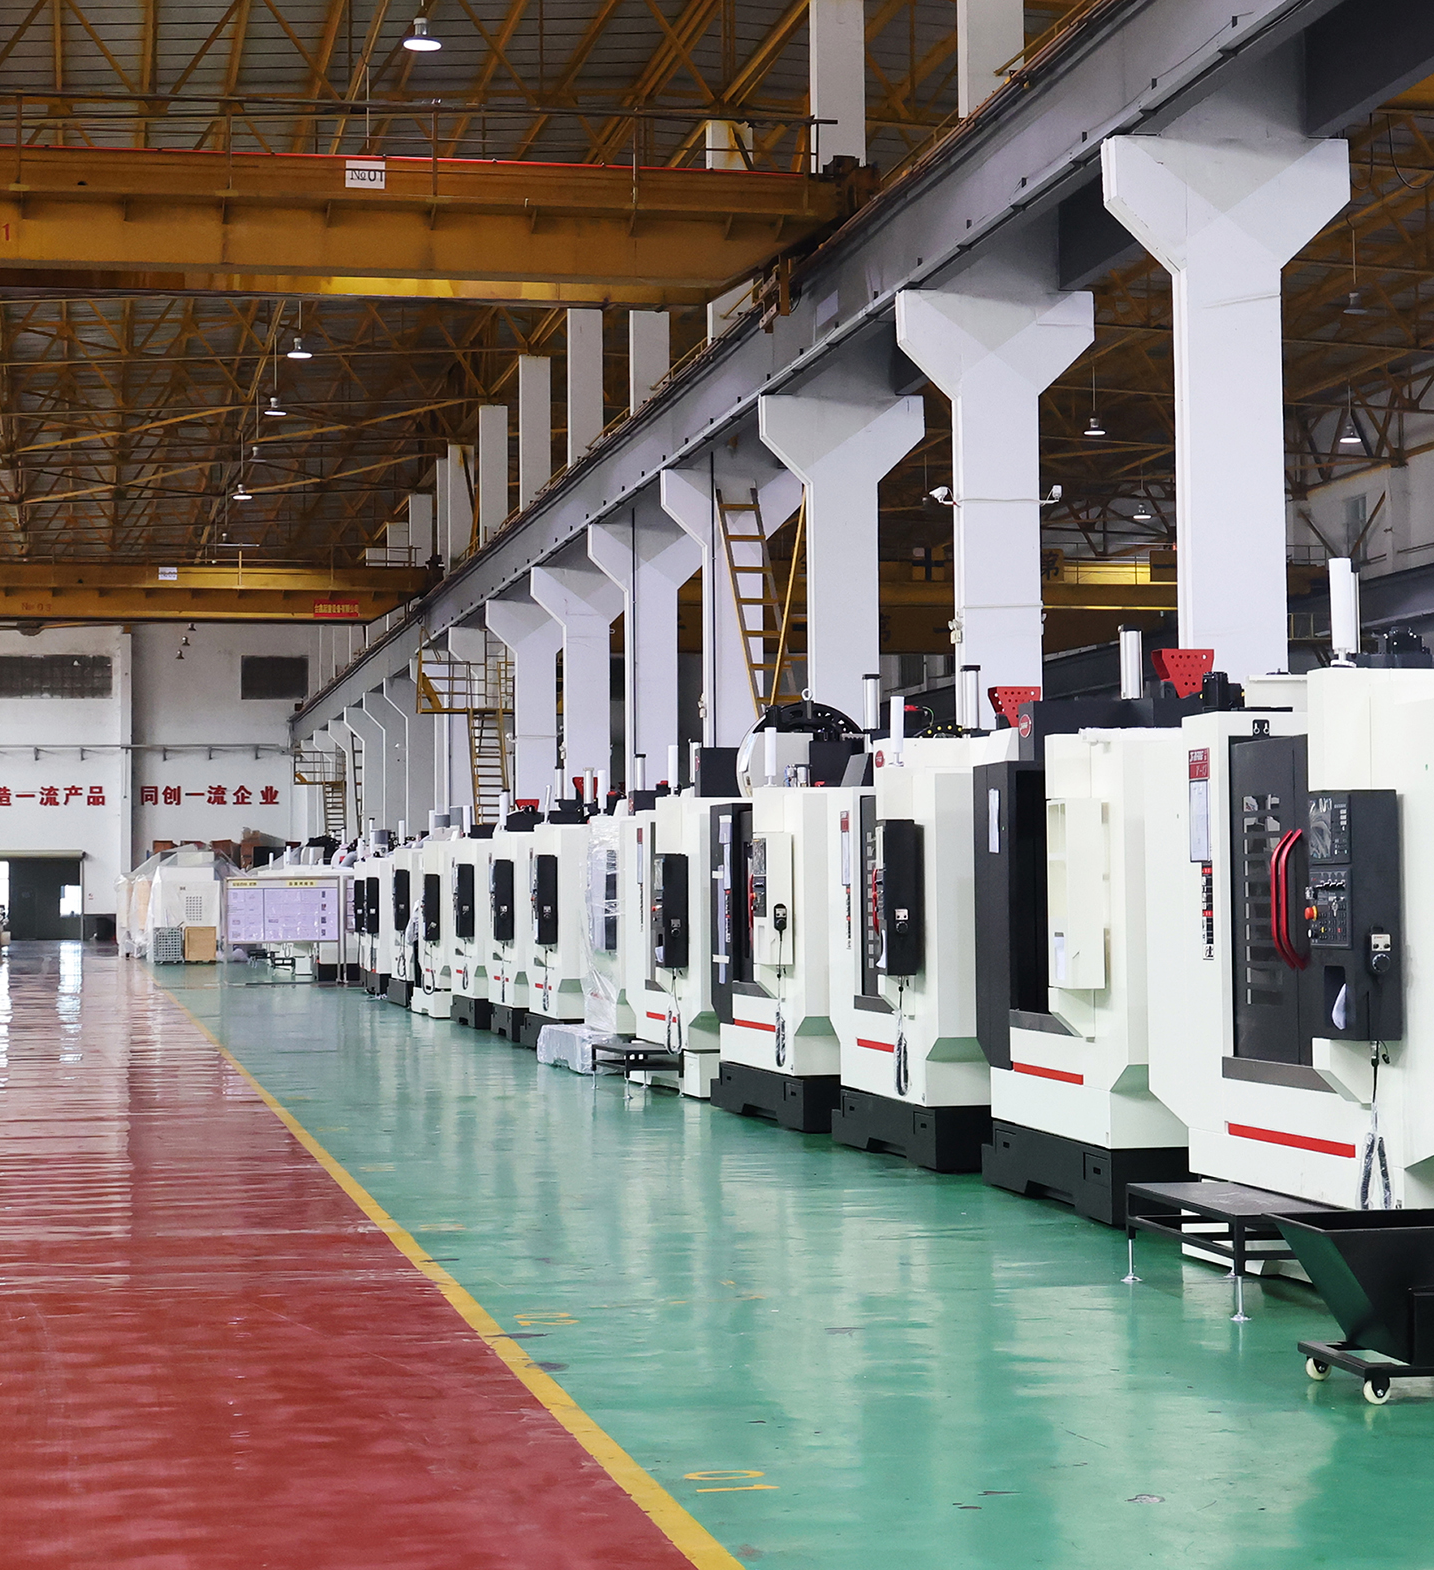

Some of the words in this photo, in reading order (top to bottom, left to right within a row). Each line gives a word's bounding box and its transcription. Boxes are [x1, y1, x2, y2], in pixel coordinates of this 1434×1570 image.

[141, 785, 279, 806] 同创一流企业
